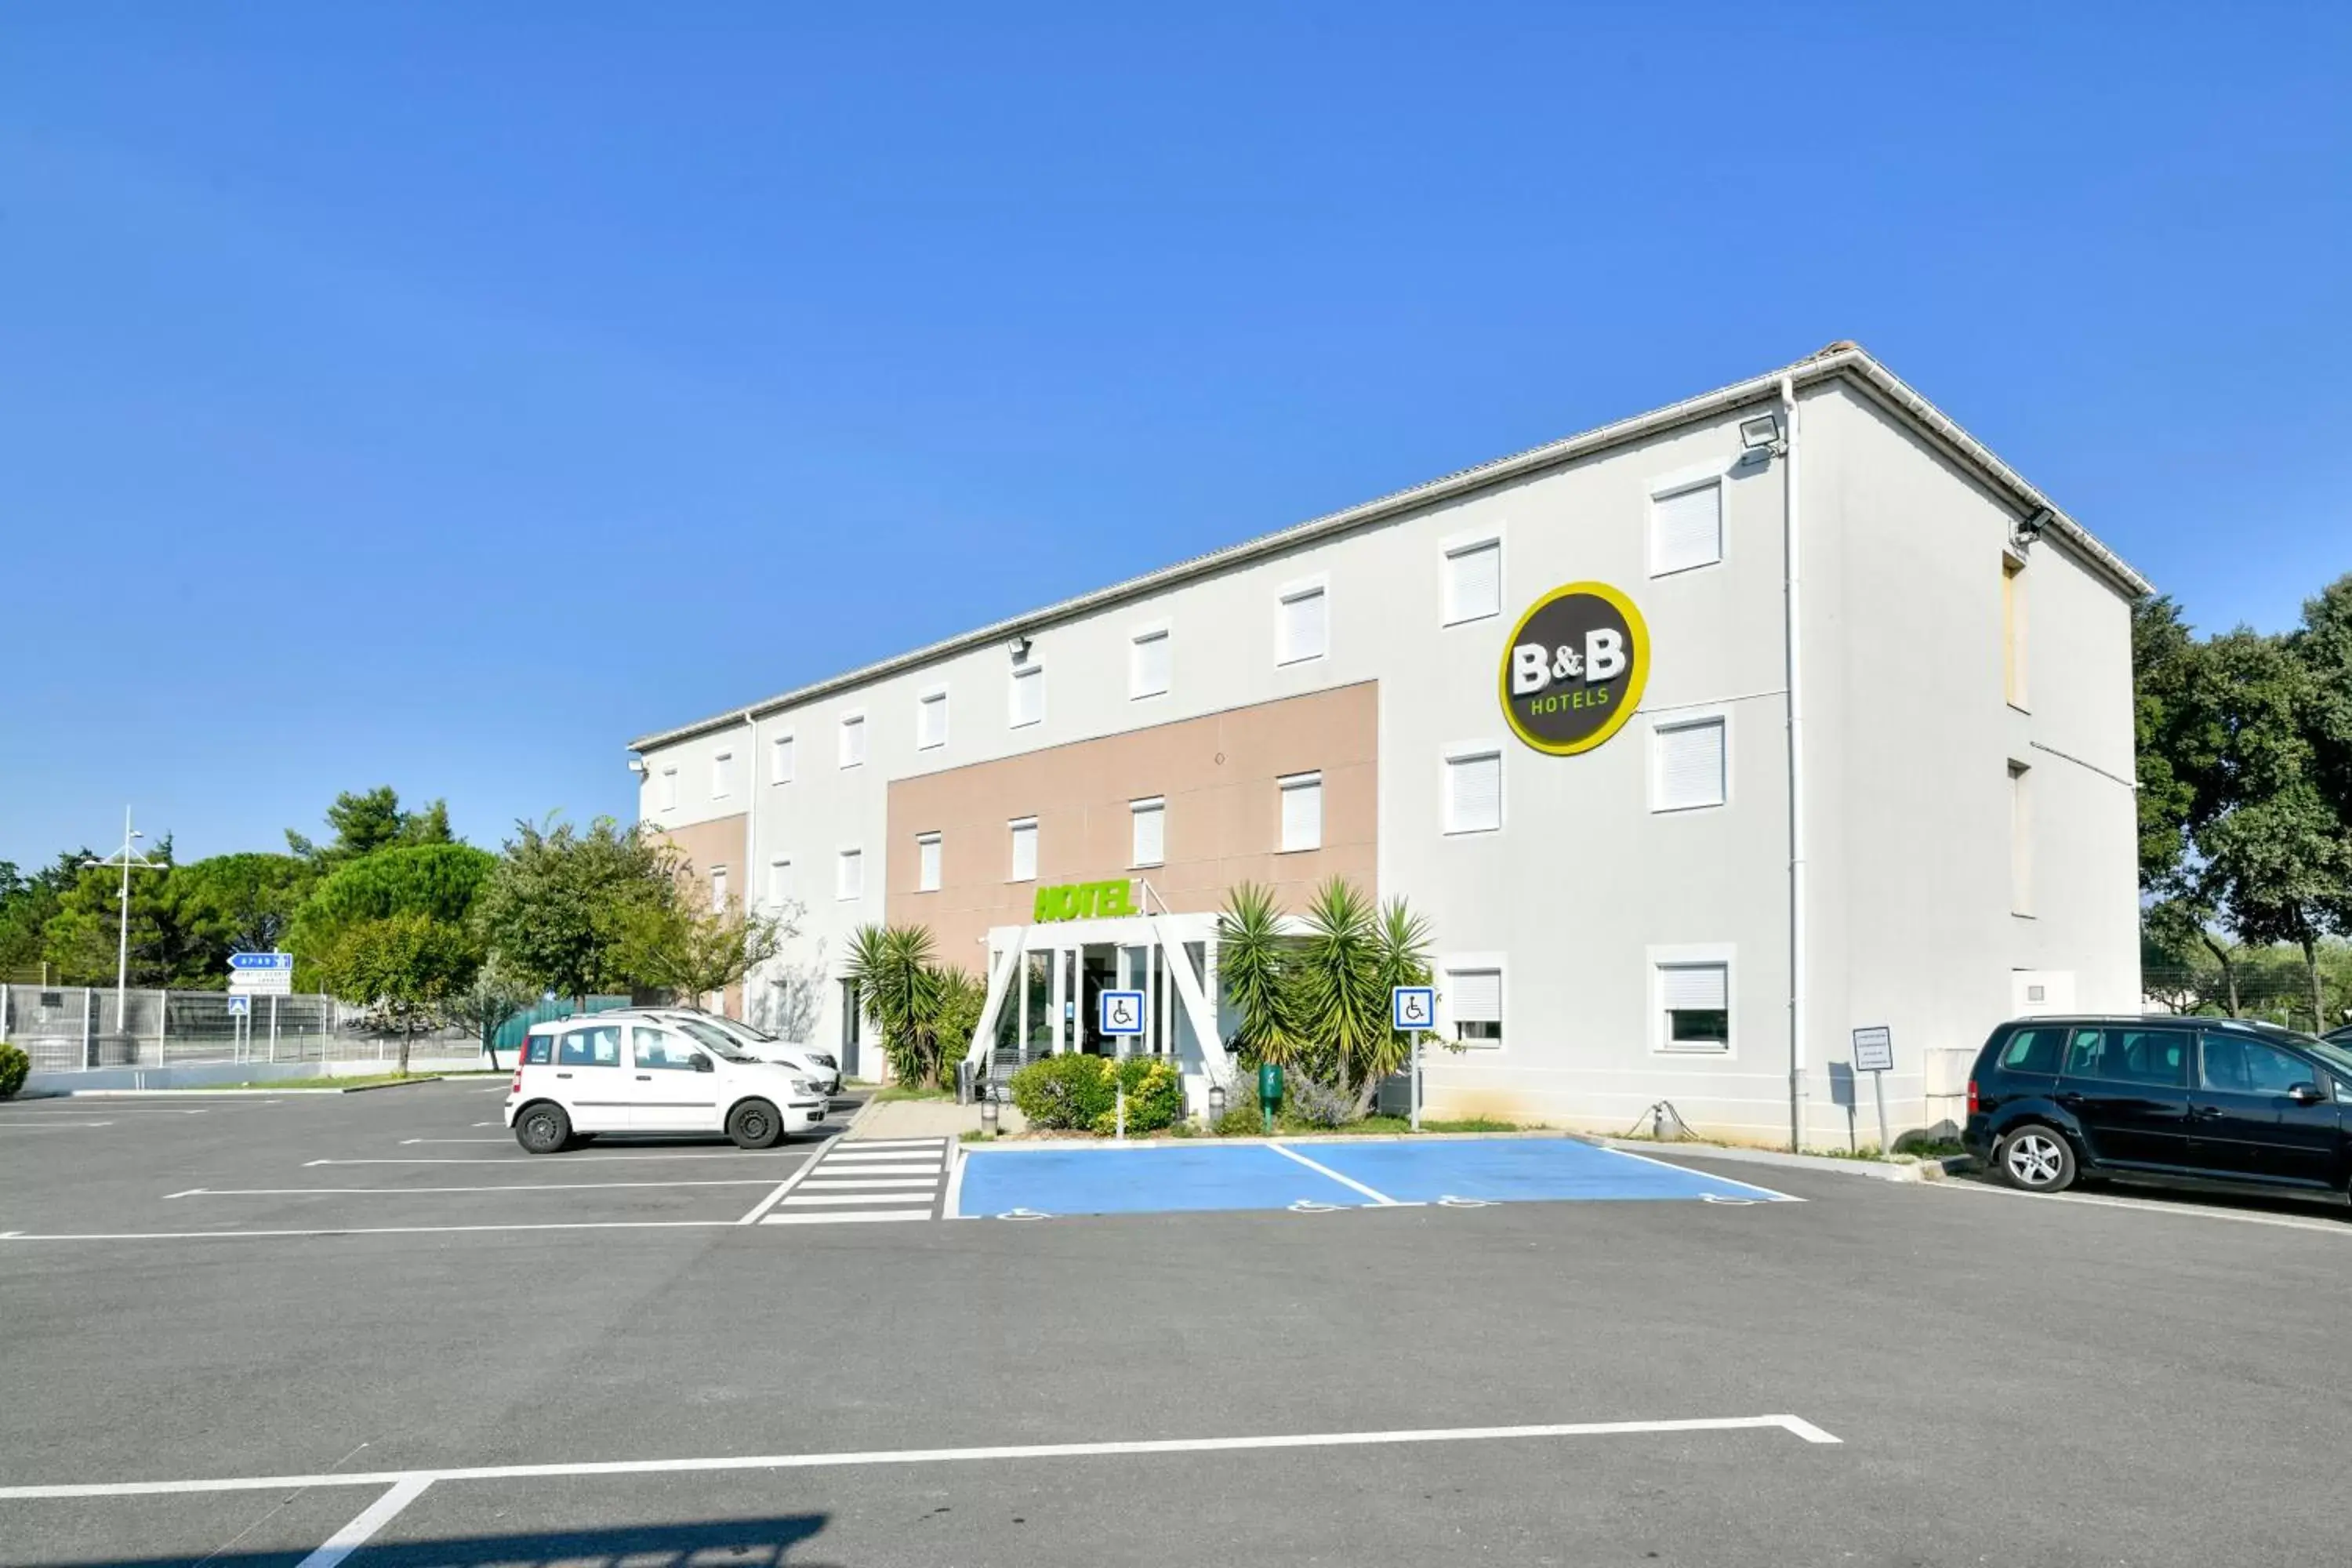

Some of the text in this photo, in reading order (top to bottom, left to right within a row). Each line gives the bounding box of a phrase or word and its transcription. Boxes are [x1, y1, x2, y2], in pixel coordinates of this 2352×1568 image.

[1513, 628, 1626, 695] B&B
[1531, 688, 1609, 715] HOTELS
[1034, 879, 1138, 923] HOTEL
